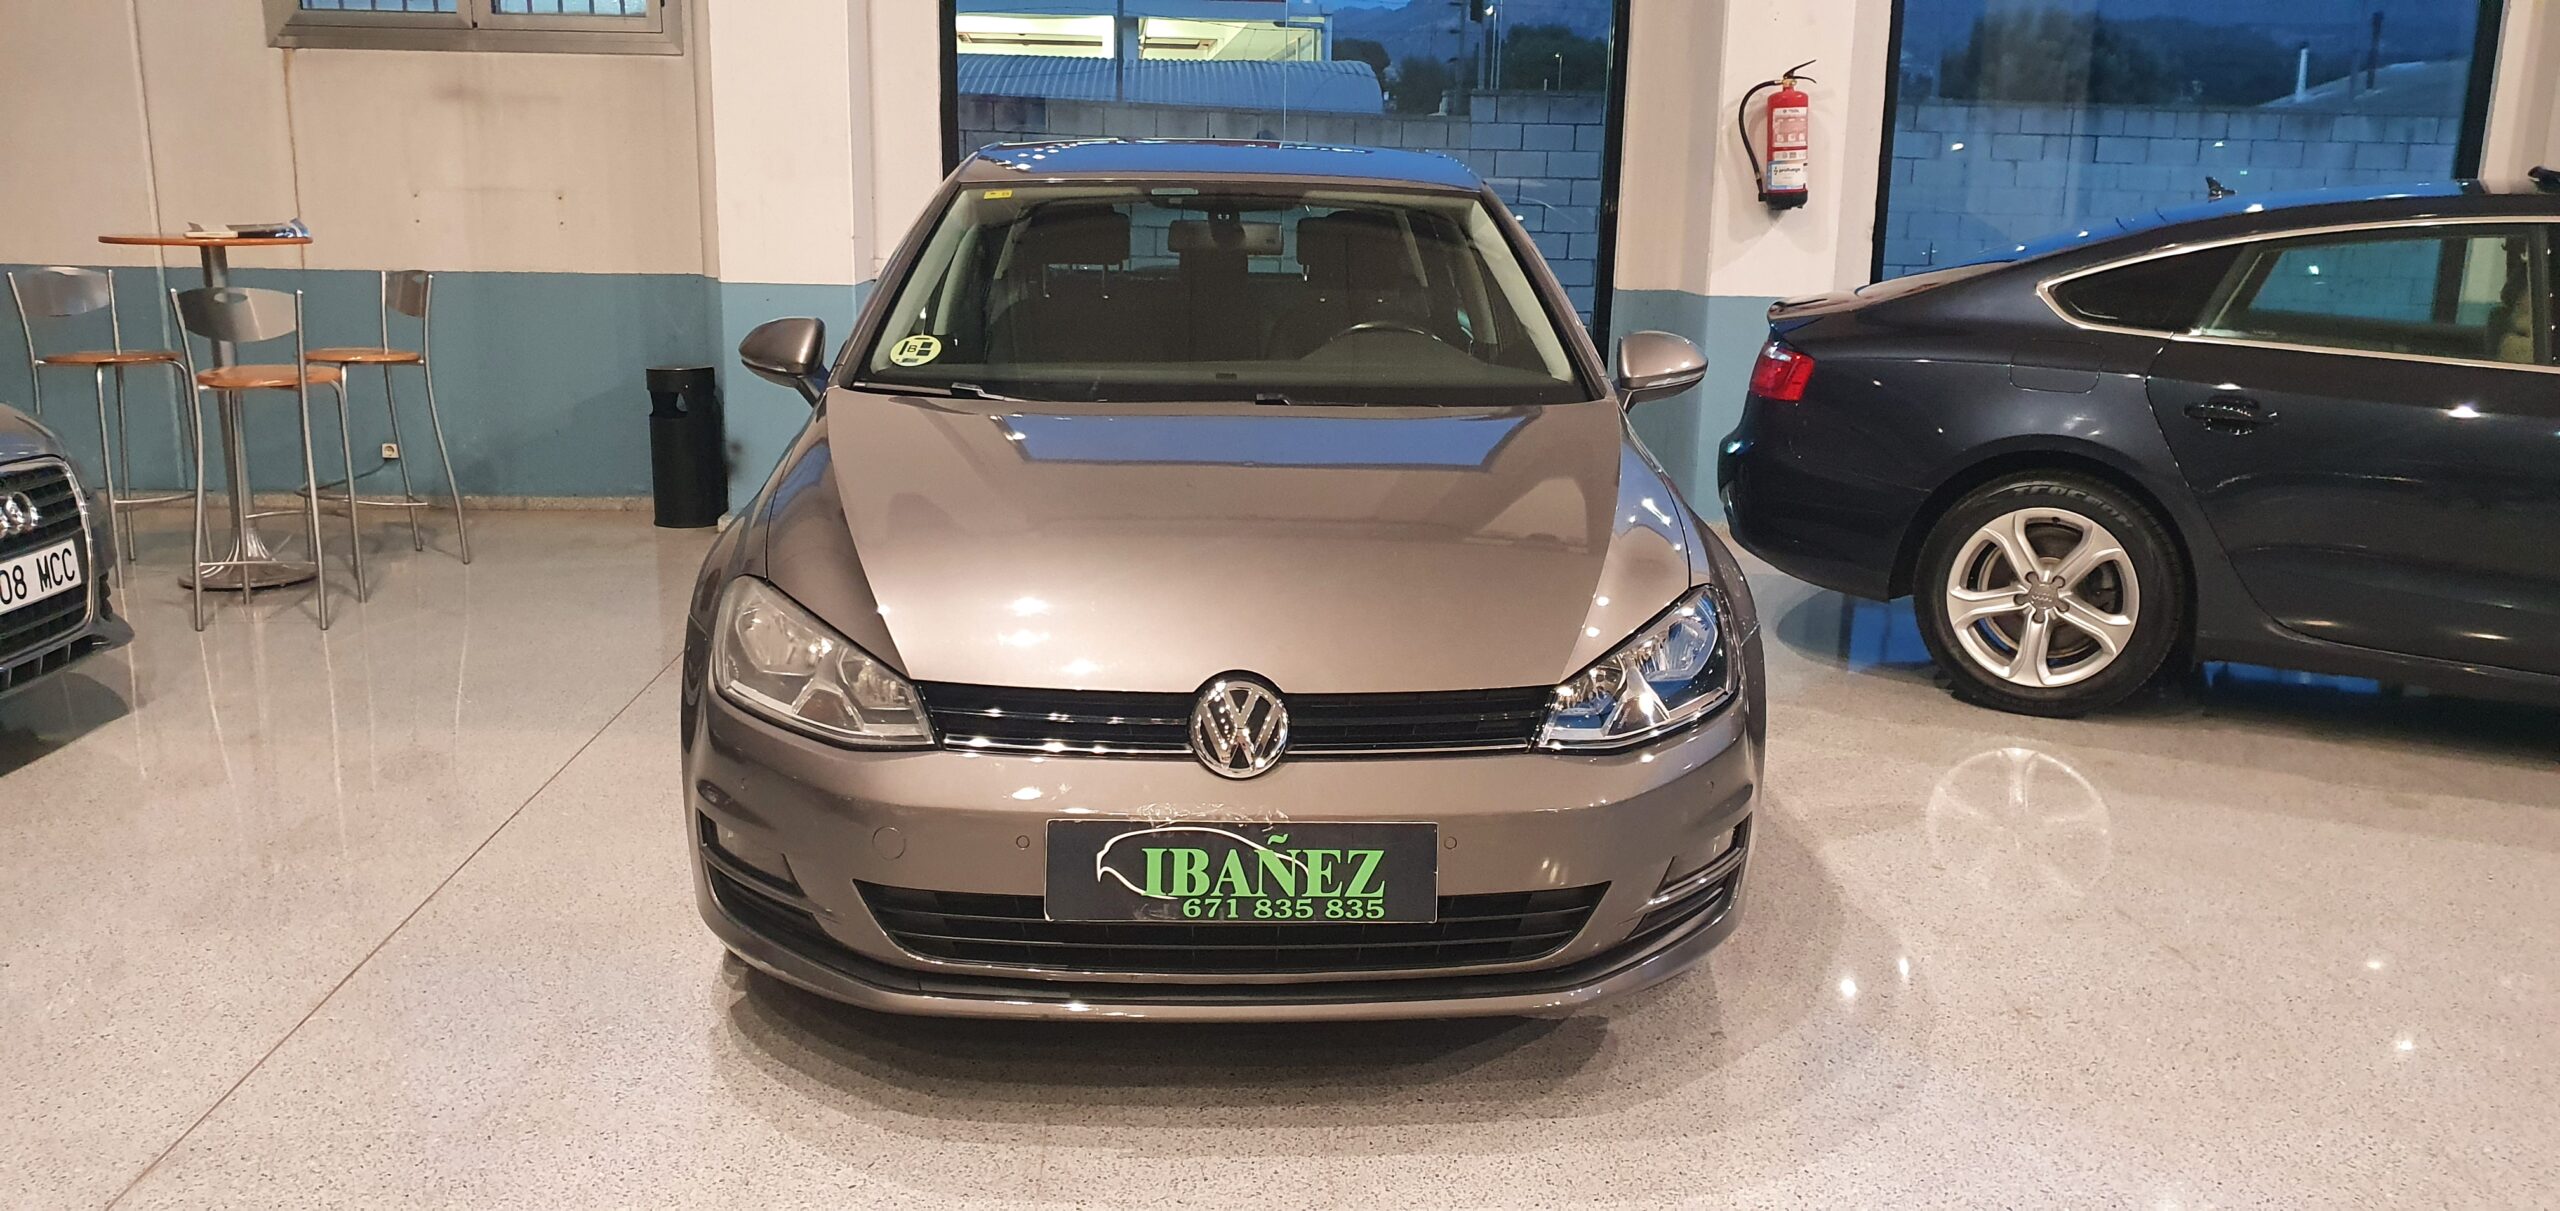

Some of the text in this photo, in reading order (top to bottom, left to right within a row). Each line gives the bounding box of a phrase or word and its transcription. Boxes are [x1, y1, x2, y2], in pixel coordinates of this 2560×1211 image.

[36, 548, 75, 592] MCC
[1142, 833, 1386, 898] IBAÑEZ
[1183, 899, 1385, 918] 671 835 835
